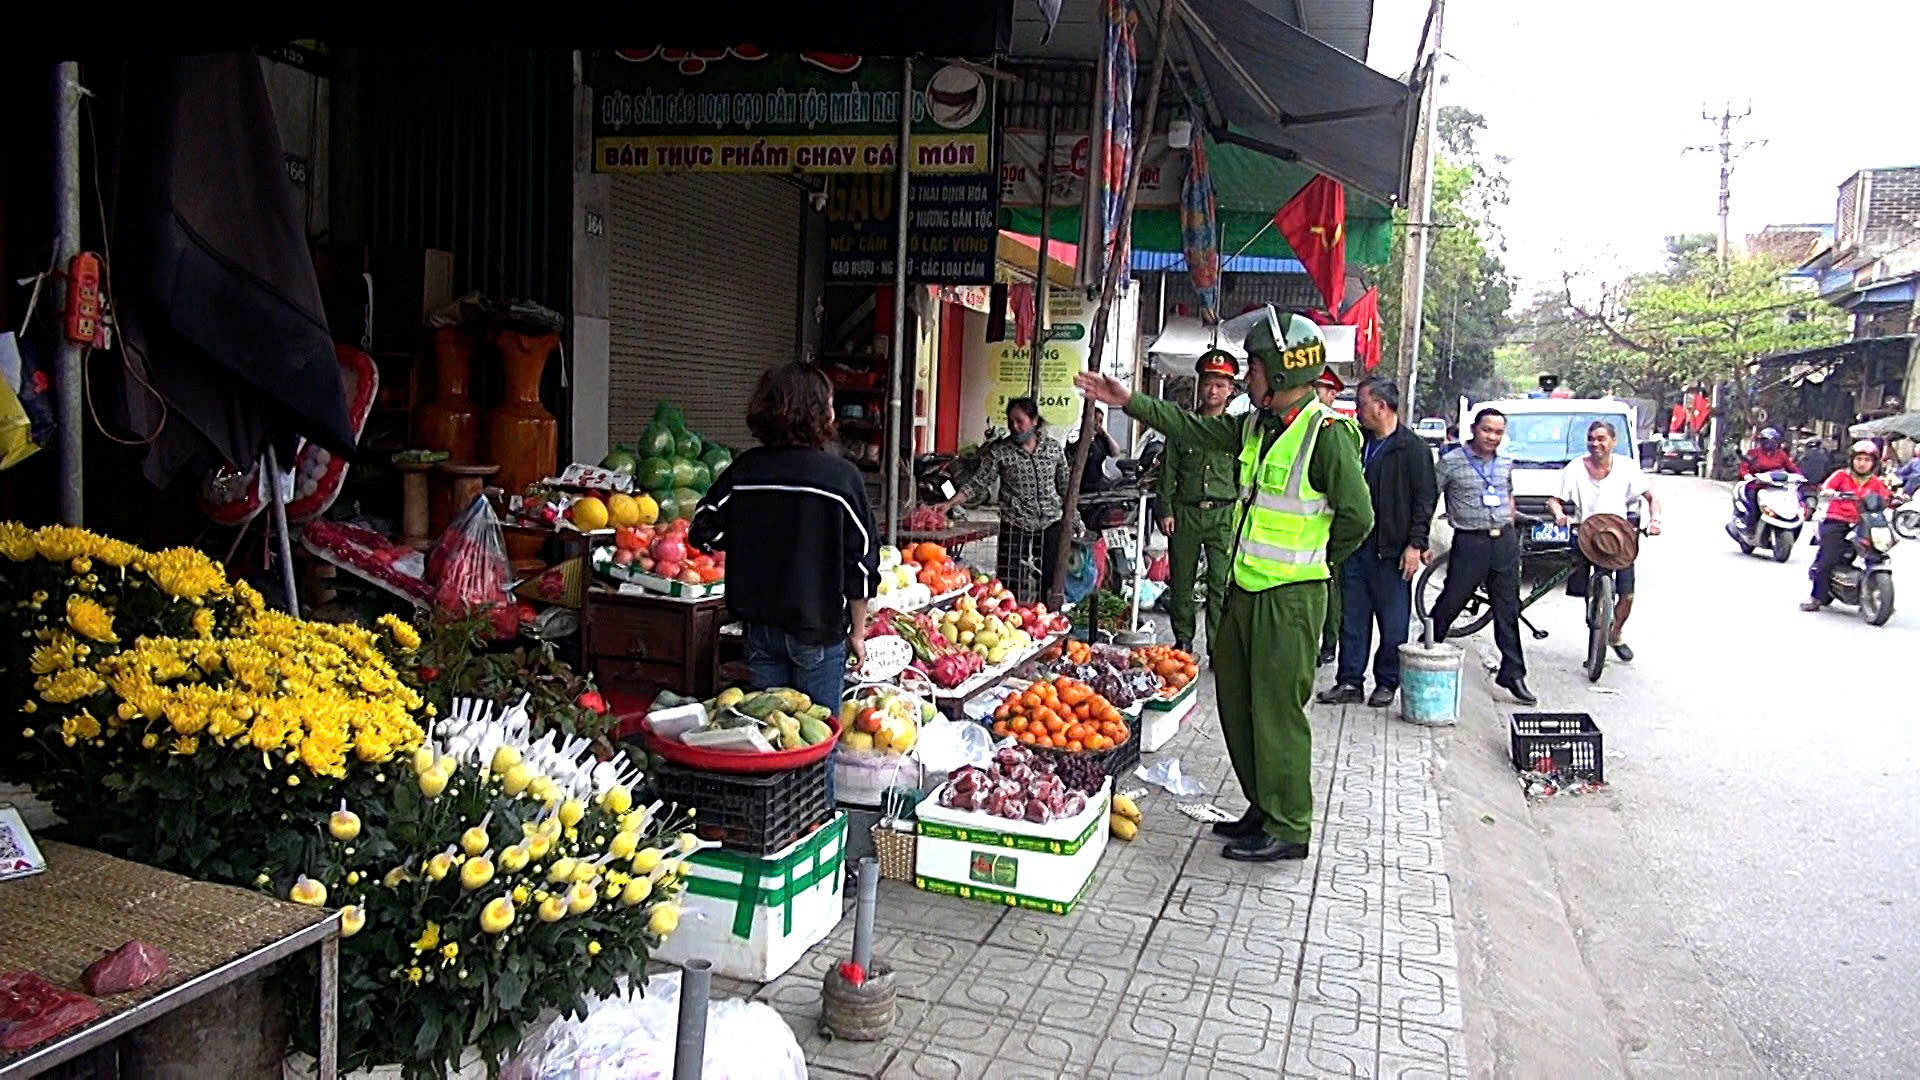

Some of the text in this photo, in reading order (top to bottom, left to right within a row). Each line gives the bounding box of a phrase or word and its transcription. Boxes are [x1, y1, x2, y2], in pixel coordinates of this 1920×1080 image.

[634, 86, 664, 125] SẢN
[666, 87, 695, 125] CÁC
[697, 93, 731, 129] LOẠI
[733, 93, 763, 129] GẠO
[765, 87, 797, 124] DÂN
[799, 87, 828, 129] TỘC
[830, 81, 870, 123] MIỀN
[605, 138, 975, 168] BÁN THỰC PHẨM CHAY CÁ MÓN
[967, 182, 988, 202] HÓA
[974, 207, 993, 231] TỘC
[921, 257, 940, 276] CÁC
[1001, 349, 1060, 360] 4 KHNG
[1283, 345, 1322, 369] CSTT
